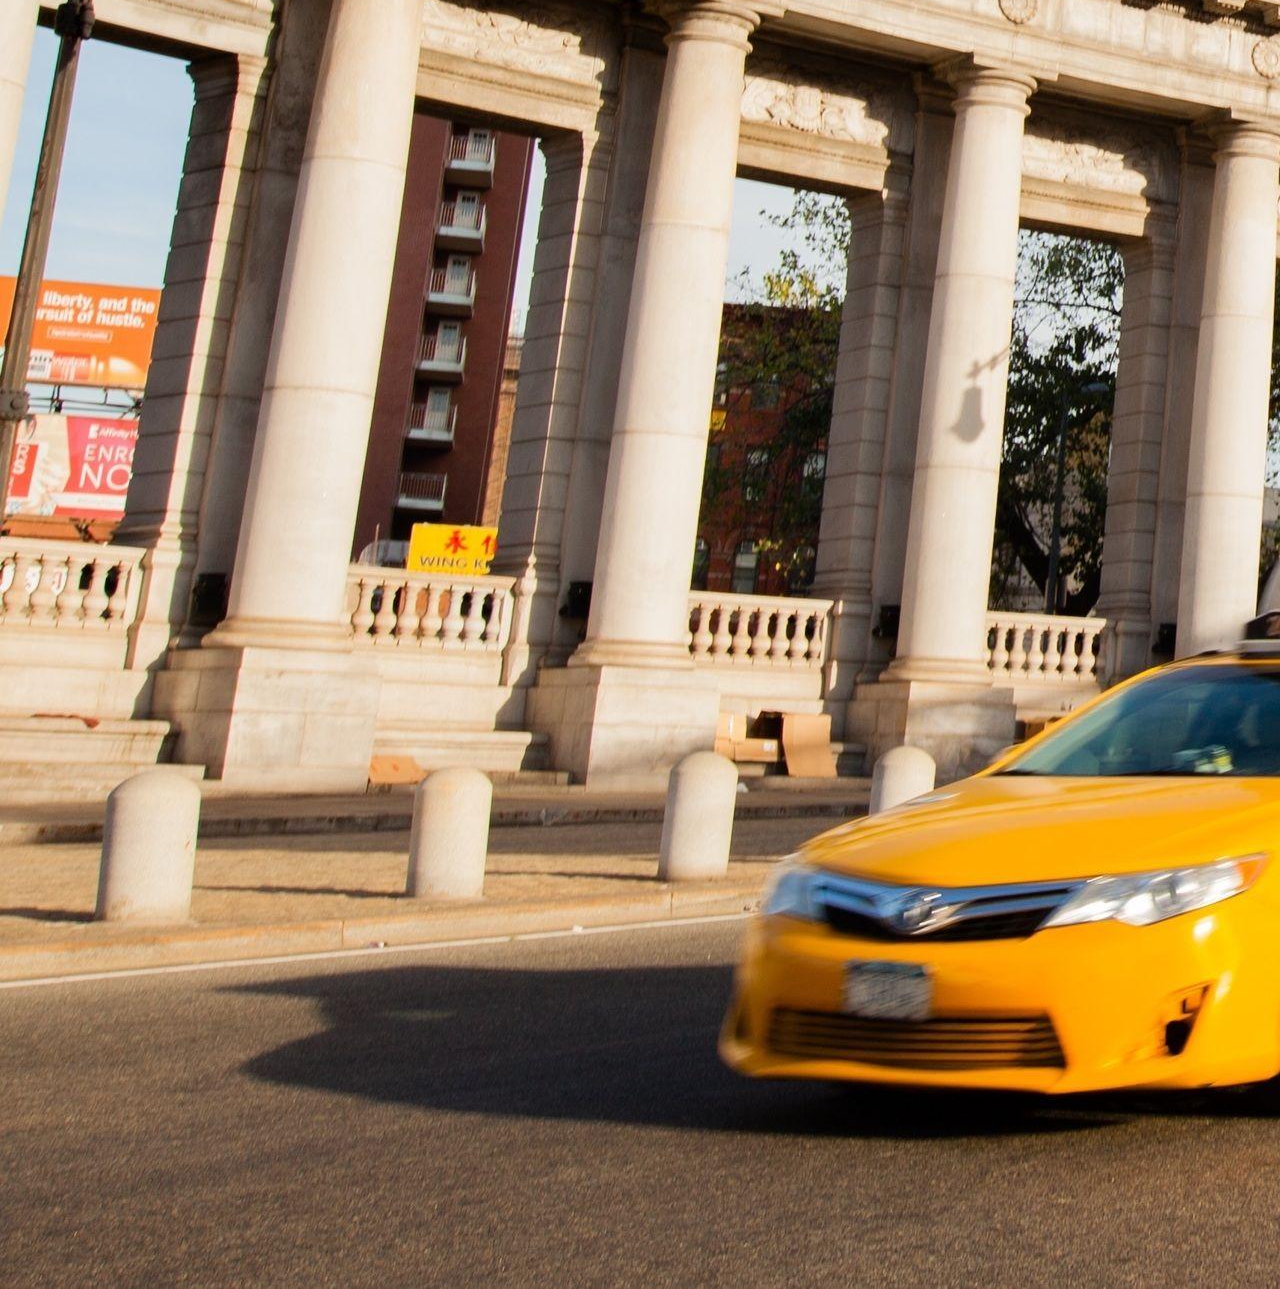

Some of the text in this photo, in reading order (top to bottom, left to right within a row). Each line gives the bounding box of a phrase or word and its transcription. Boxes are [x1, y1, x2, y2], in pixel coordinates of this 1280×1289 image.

[42, 290, 155, 314] liberty, and the
[36, 307, 145, 329] rsuit of hustle.
[420, 556, 467, 568] WING
